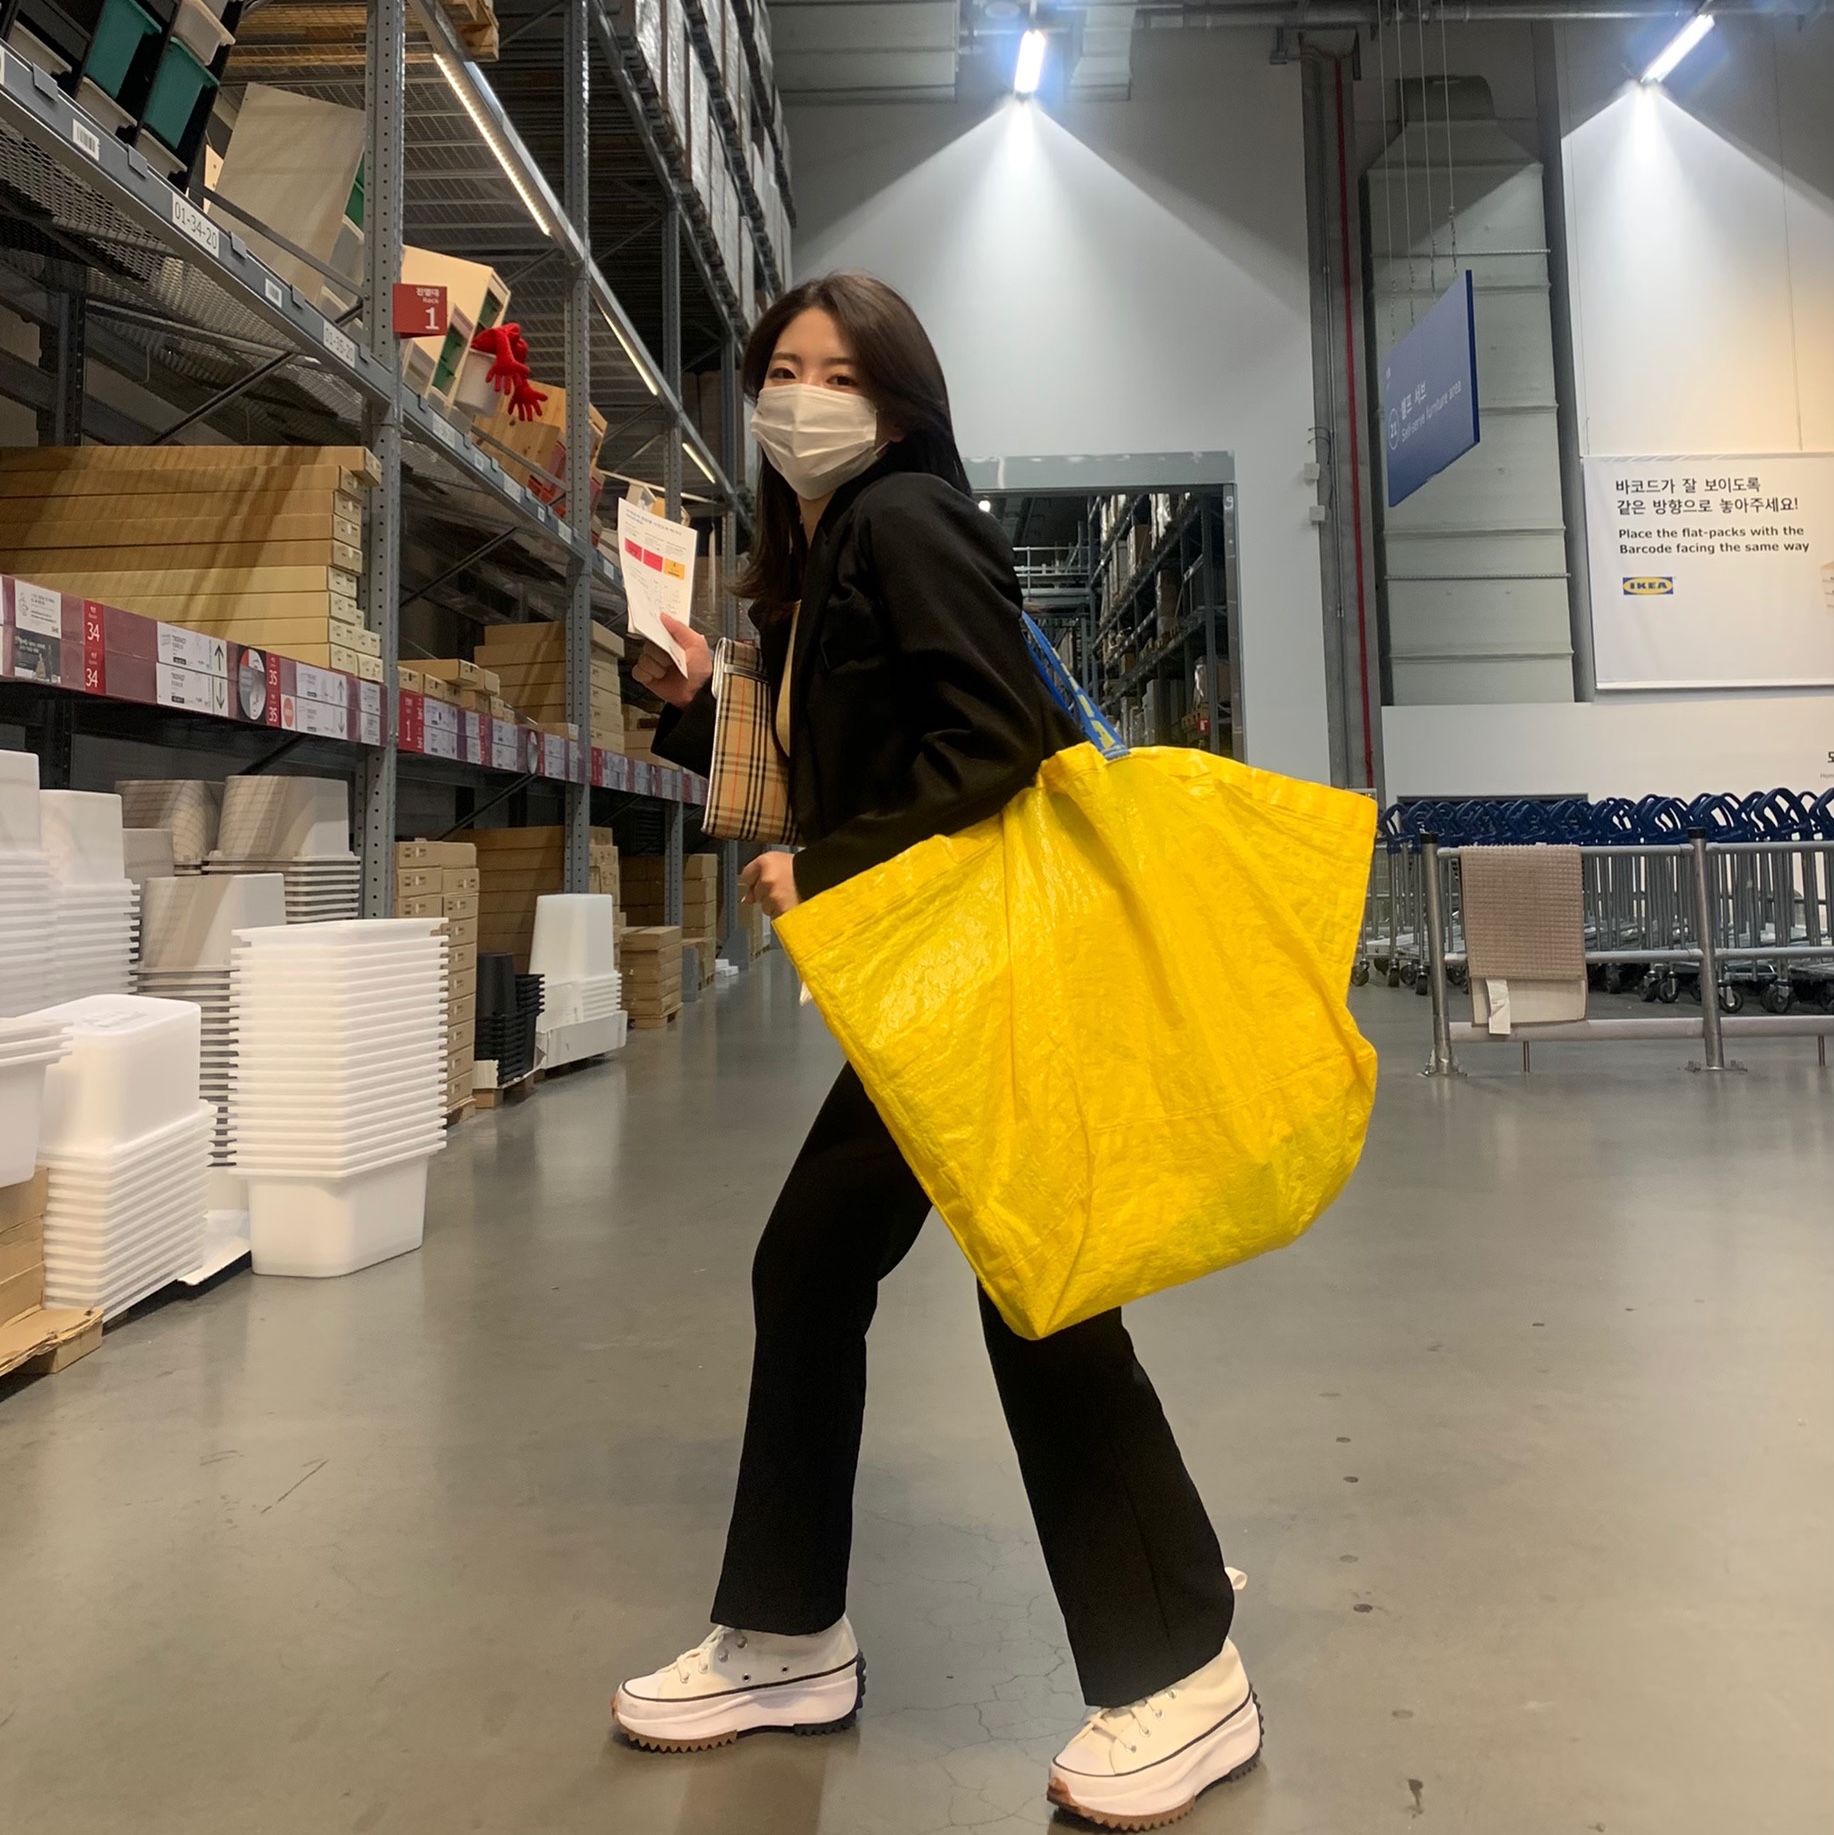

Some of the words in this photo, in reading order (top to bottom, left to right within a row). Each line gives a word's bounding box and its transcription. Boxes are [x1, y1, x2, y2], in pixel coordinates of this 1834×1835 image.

[174, 201, 219, 251] 01-34-20
[424, 307, 439, 330] 1
[1616, 478, 1675, 495] 바코드가
[1682, 478, 1696, 494] 잘
[1704, 477, 1761, 493] 보이도록
[1617, 499, 1646, 516] 같은
[1652, 499, 1713, 515] 방향으로
[1719, 497, 1799, 514] 놓아주세요!
[1619, 529, 1652, 539] Place
[1657, 528, 1678, 538] the
[1682, 526, 1746, 539] flat-packs
[1750, 526, 1778, 537] with
[1783, 525, 1804, 536] the
[1619, 544, 1672, 555] Barcode
[1676, 543, 1715, 555] facing
[1719, 542, 1740, 553] the
[1745, 543, 1779, 552] same
[1783, 543, 1810, 553] way
[1629, 581, 1669, 590] IKEA
[87, 621, 101, 643] 34
[85, 668, 99, 688] 34
[268, 669, 278, 686] 35
[268, 706, 278, 723] 35
[405, 719, 412, 741] 1
